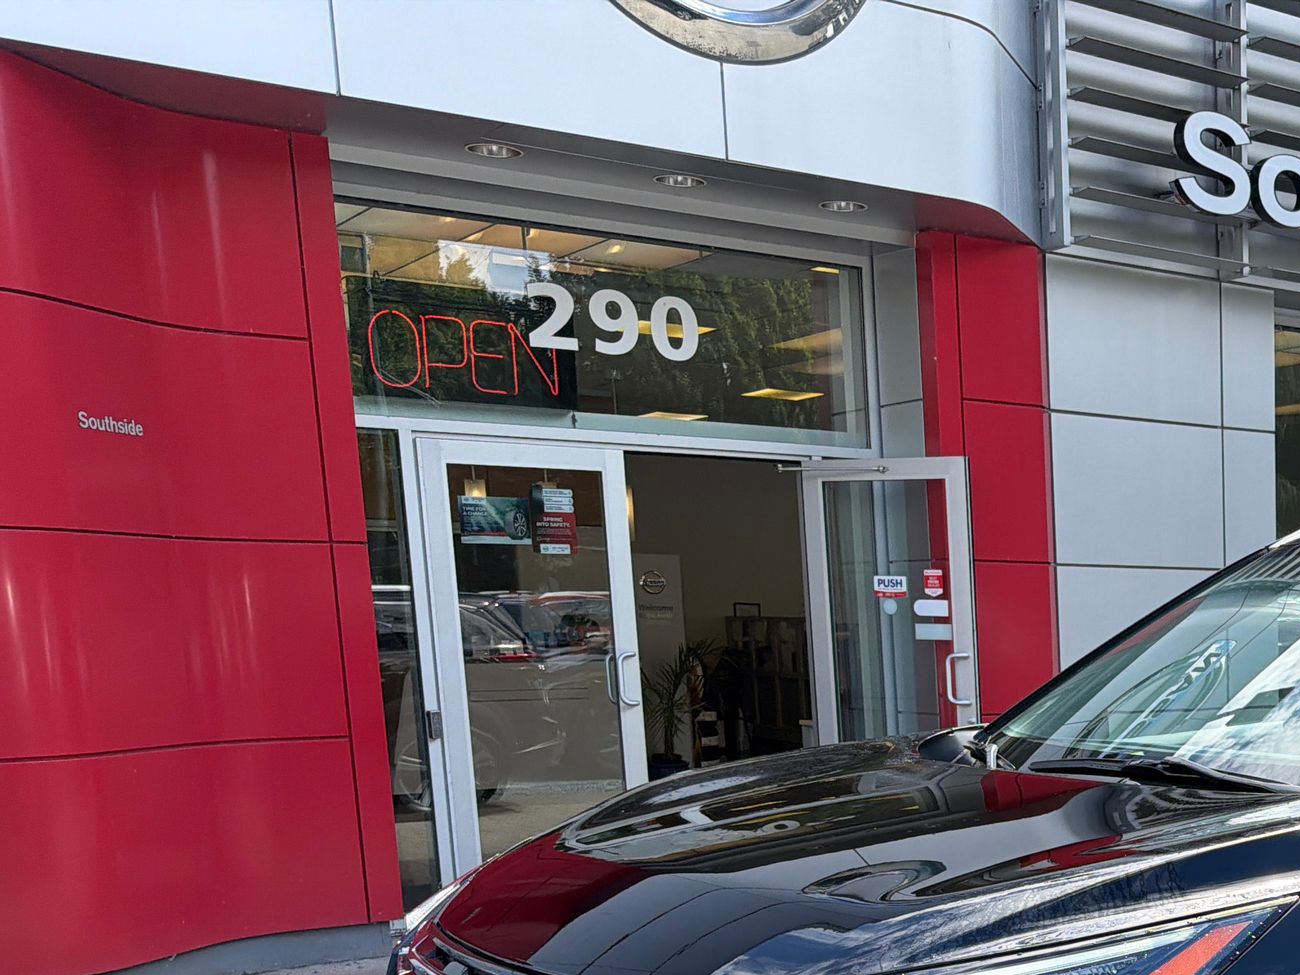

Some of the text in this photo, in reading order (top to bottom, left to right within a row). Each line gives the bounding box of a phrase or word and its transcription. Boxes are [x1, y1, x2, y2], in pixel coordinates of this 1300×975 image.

[526, 282, 700, 362] 290
[367, 309, 559, 396] OPEN
[78, 411, 144, 436] Southside
[877, 578, 903, 588] PUSH
